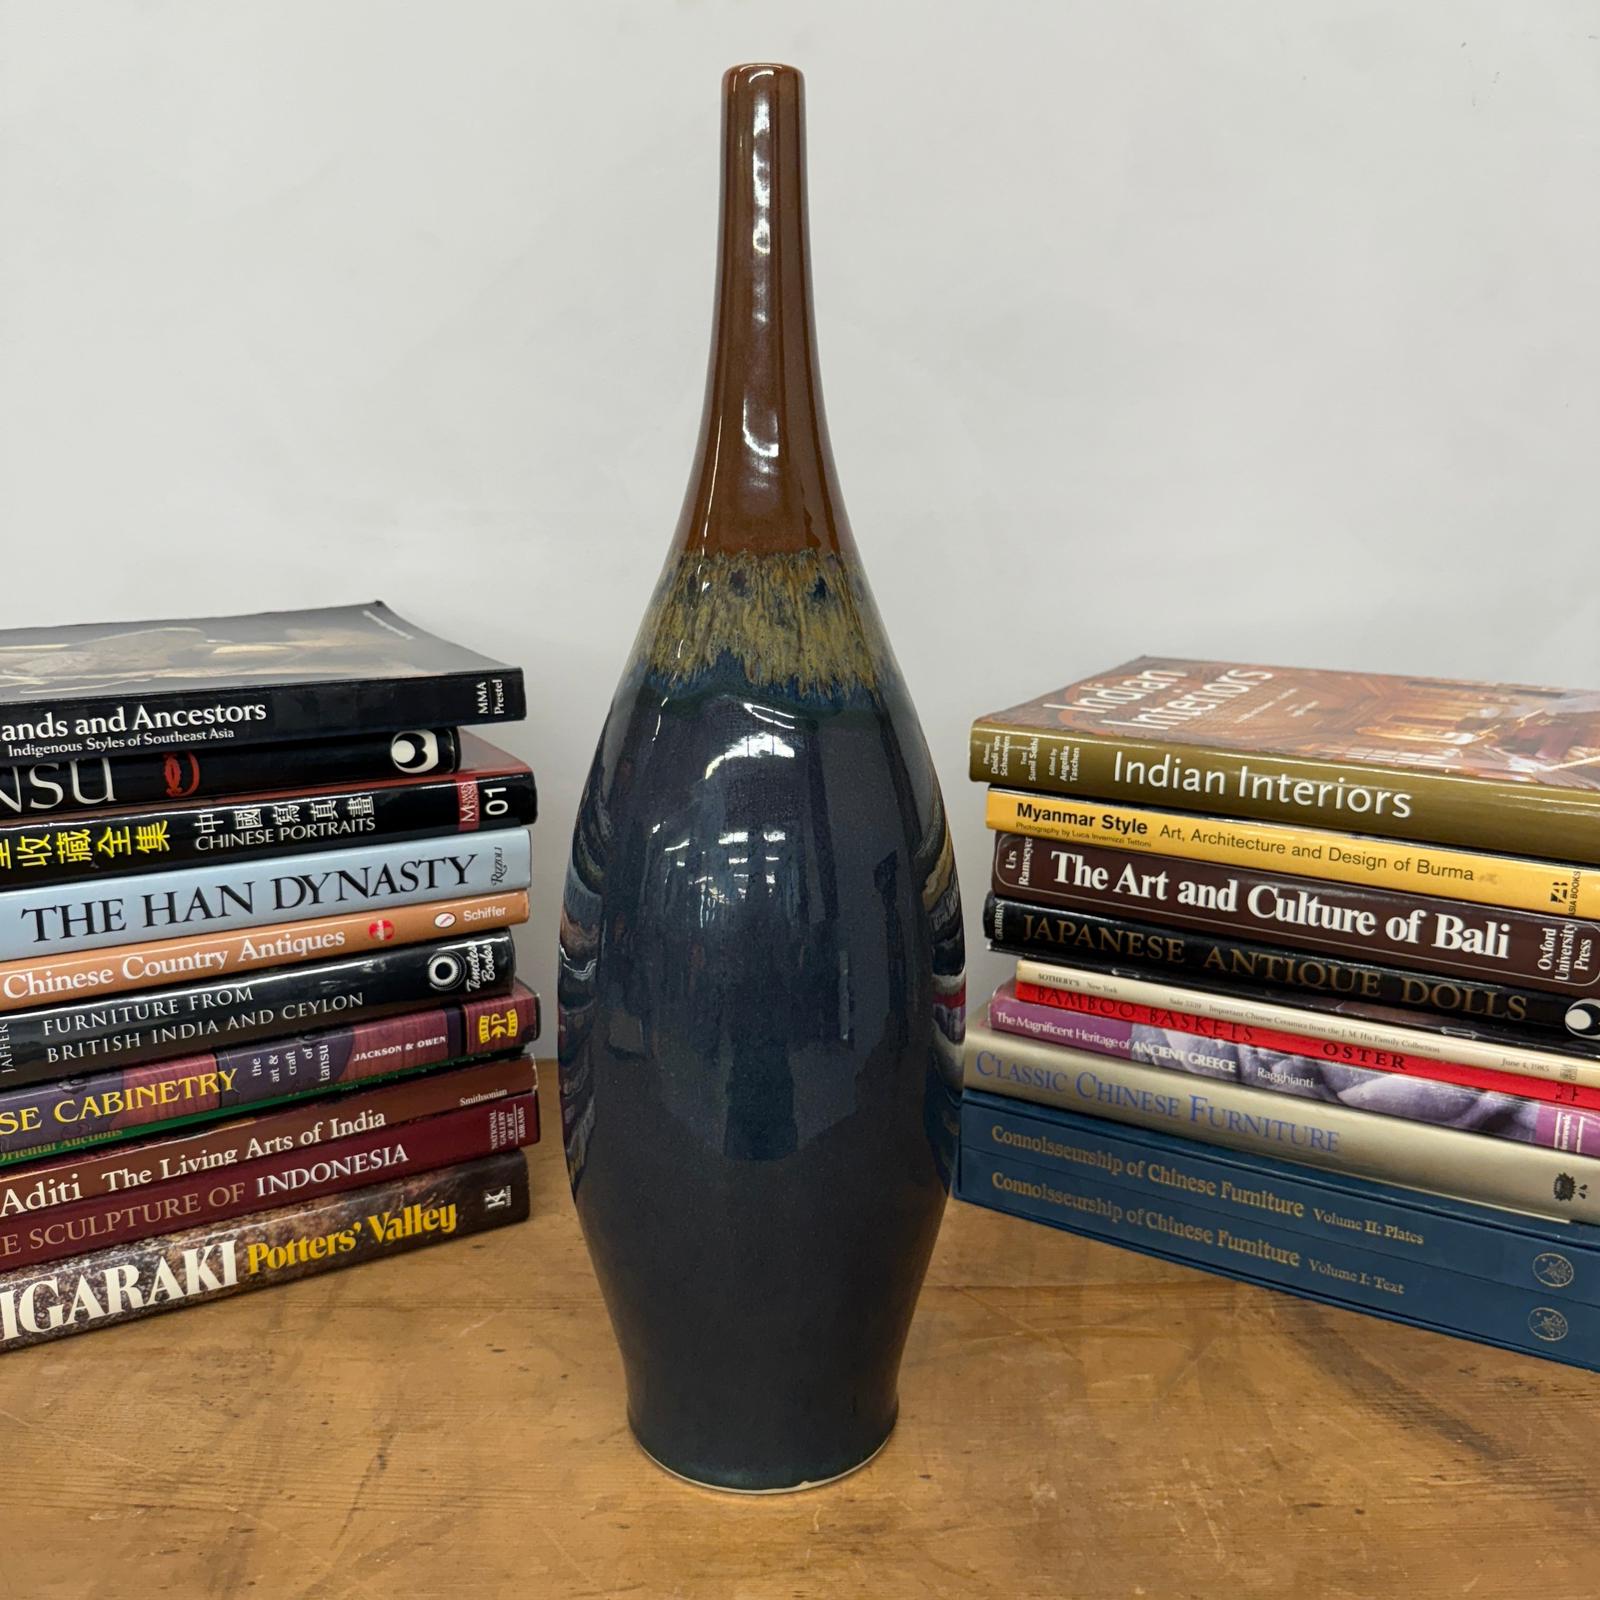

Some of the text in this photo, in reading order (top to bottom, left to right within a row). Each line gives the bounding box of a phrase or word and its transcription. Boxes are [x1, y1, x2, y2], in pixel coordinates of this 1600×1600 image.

[478, 681, 489, 714] MMA
[494, 678, 505, 715] Prestel
[1043, 668, 1187, 713] Indian
[1101, 669, 1273, 731] Interiors
[0, 703, 267, 742] ands and Ancestors
[8, 727, 235, 758] Indigenous Styles of Southeast Asia
[1028, 760, 1037, 781] Sunil
[1060, 745, 1070, 782] Angelika
[1069, 747, 1080, 782] Taschen
[1114, 751, 1412, 819] Indian Interiors
[485, 786, 509, 816] 01
[195, 817, 375, 850] CHINESE PORTRAITS
[1016, 803, 1474, 881] Myanmar Style Art, Architecture and Design of Burma
[1006, 850, 1017, 869] Urs
[1019, 837, 1033, 886] Ramseyer
[21, 854, 478, 943] THE HAN DYNASTY
[1050, 851, 1510, 959] The Art and Culture of Bali
[1569, 871, 1581, 900] BOOKS
[464, 906, 507, 922] Schiffer
[4, 931, 345, 999] Chinese Country Antiques
[466, 943, 482, 993] Timeles
[481, 943, 496, 981] Books
[1023, 915, 1527, 1021] JAPANESE ANTIQUE DOLLS
[1537, 928, 1557, 971] Oxford
[1554, 922, 1578, 982] University
[1573, 939, 1592, 971] Press
[43, 987, 254, 1036] FURNITURE FROM
[47, 992, 364, 1064] BRITISH INDIA AND CEYLON
[1037, 985, 1137, 1018] BAMBOO
[1322, 1042, 1408, 1070] OSTER
[252, 1057, 262, 1077] the
[287, 1051, 297, 1076] craft
[302, 1046, 313, 1059] of
[353, 1035, 447, 1062] JACKSON & OWEN
[996, 1011, 1314, 1089] The Magnificent Heritage of ANCIENT GREECE Ragghianti
[54, 1068, 238, 1124] CABINETRY
[272, 1068, 280, 1082] art
[459, 1088, 508, 1106] Smithsonian
[975, 1050, 1340, 1152] CLASSIC CHINESE FURNITURE
[1, 1109, 386, 1217] Aditi The Living Arts of India
[992, 1125, 1122, 1174] Connoisseurship
[1126, 1160, 1145, 1176] of
[1148, 1164, 1216, 1196] Chinese
[1220, 1180, 1304, 1217] Furniture
[1313, 1207, 1362, 1232] Volume
[1384, 1225, 1425, 1245] Plates
[29, 1143, 409, 1249] SCULPTURE OF INDONESIA
[992, 1172, 1122, 1222] Connoisseurship
[1126, 1209, 1145, 1225] of
[1146, 1212, 1213, 1244] Chinese
[1217, 1228, 1300, 1267] Furniture
[1309, 1258, 1356, 1282] Volume
[0, 1239, 240, 1341] IGARAKI
[368, 1203, 457, 1244] Valley
